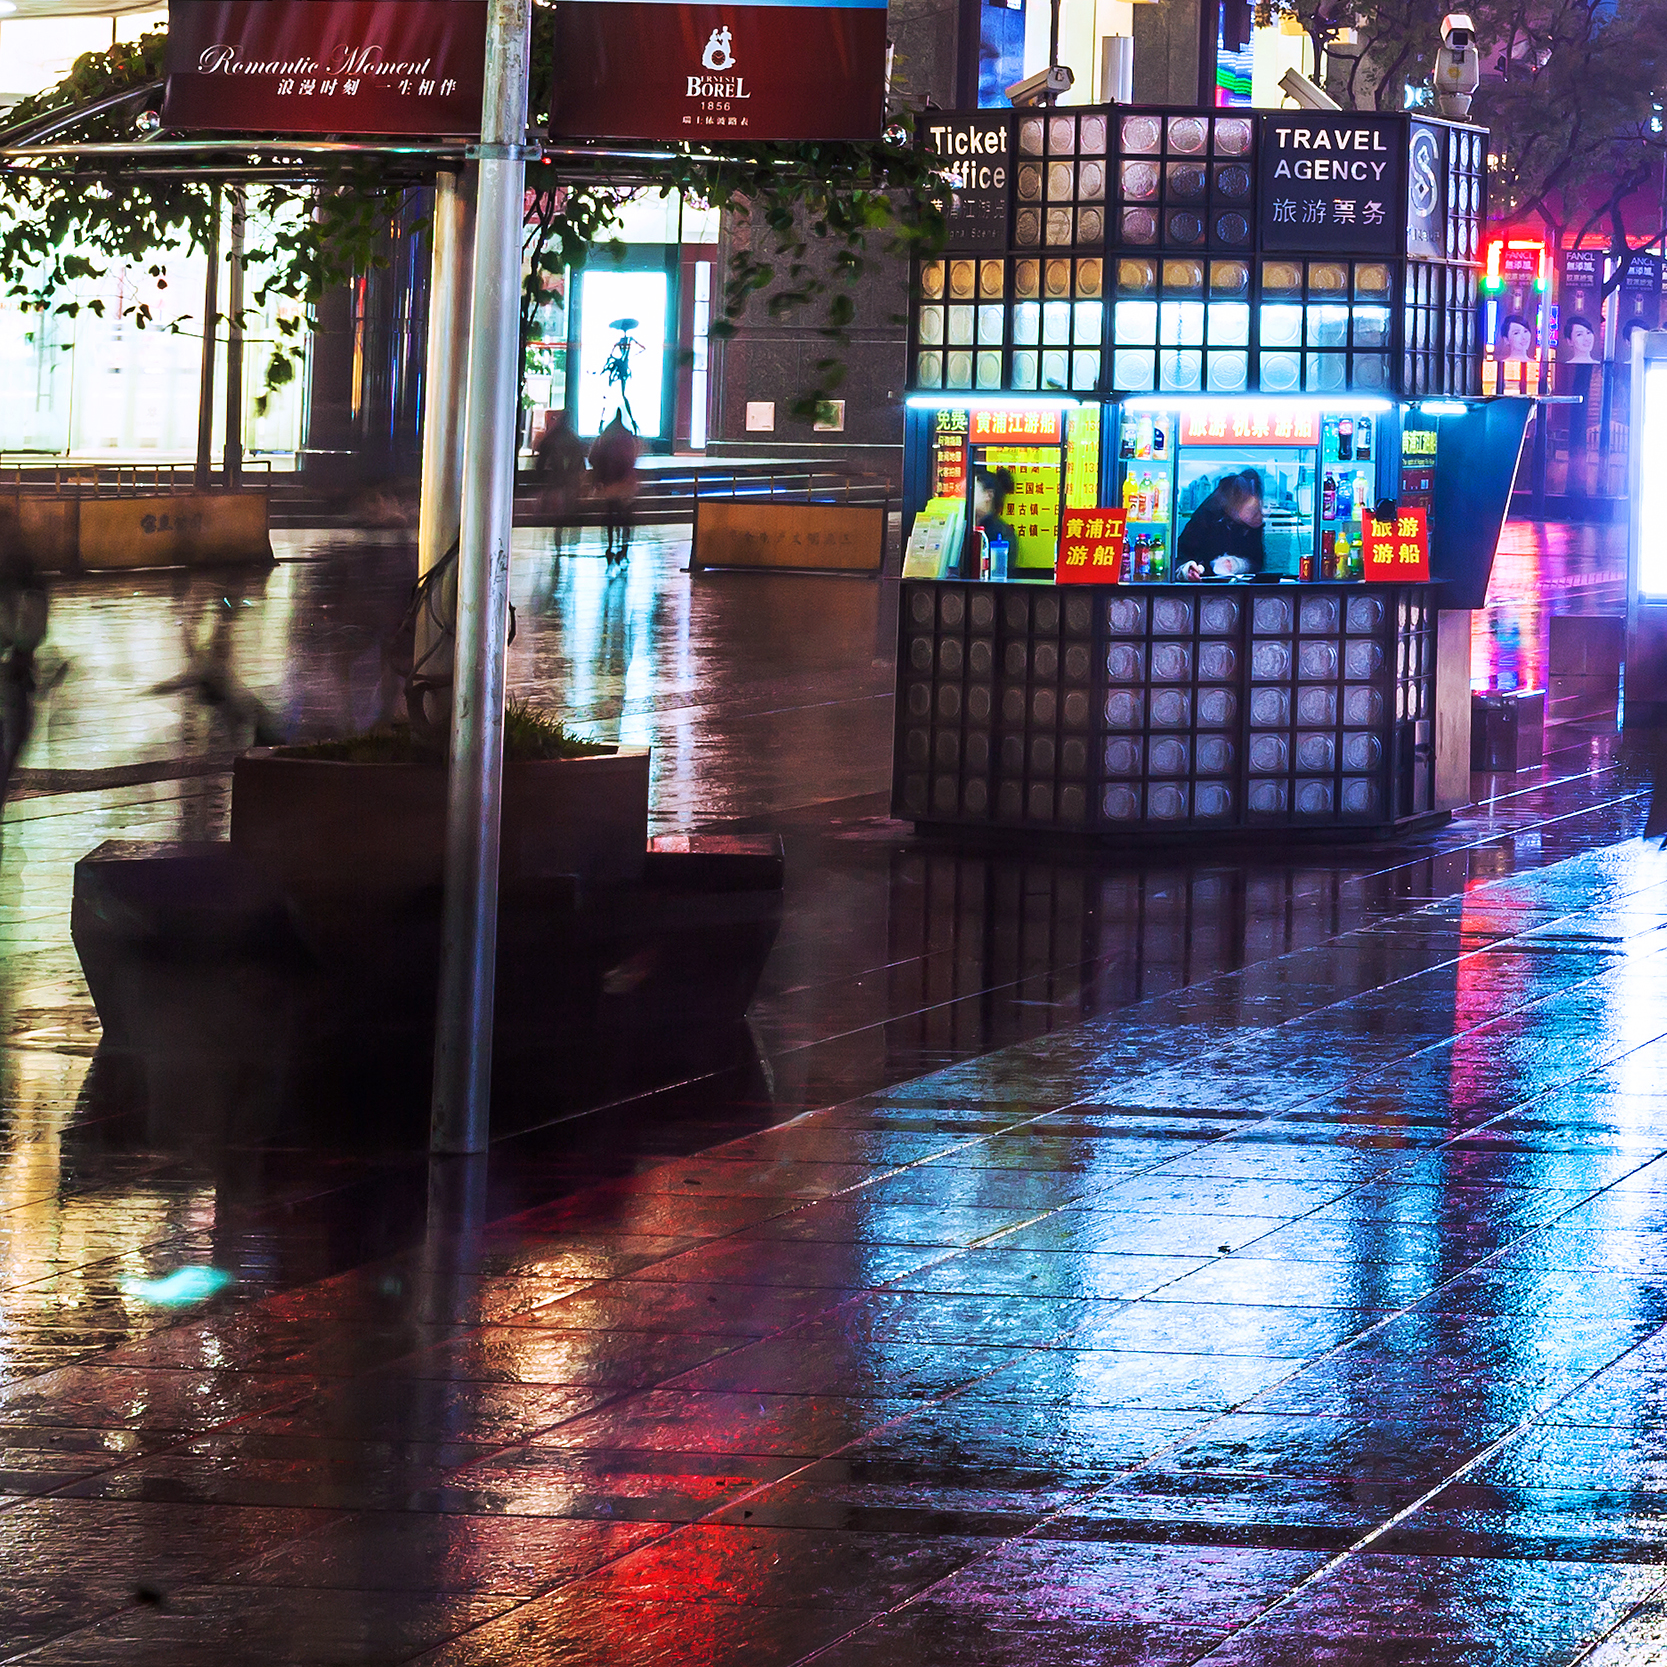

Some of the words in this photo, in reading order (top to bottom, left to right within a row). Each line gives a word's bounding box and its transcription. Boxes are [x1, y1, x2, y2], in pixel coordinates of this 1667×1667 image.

[197, 44, 319, 75] Romantic
[326, 44, 430, 75] Moment
[277, 78, 360, 96] 浪漫时刻
[375, 78, 456, 96] 一生相伴
[685, 76, 751, 99] BOREL
[701, 101, 731, 111] 1856
[930, 125, 1007, 155] Ticket
[1275, 128, 1387, 151] TRAVEL
[1274, 159, 1387, 181] AGENCY
[1273, 198, 1386, 225] 旅游票务
[1566, 252, 1595, 260] FANCL
[1631, 257, 1655, 266] ANCL
[936, 409, 968, 431] 免费
[976, 411, 1055, 434] 黄浦江游船
[1065, 518, 1124, 540] 黄浦江
[1371, 518, 1419, 538] 旅游
[1066, 545, 1116, 567] 游船
[1373, 543, 1420, 564] 游船
